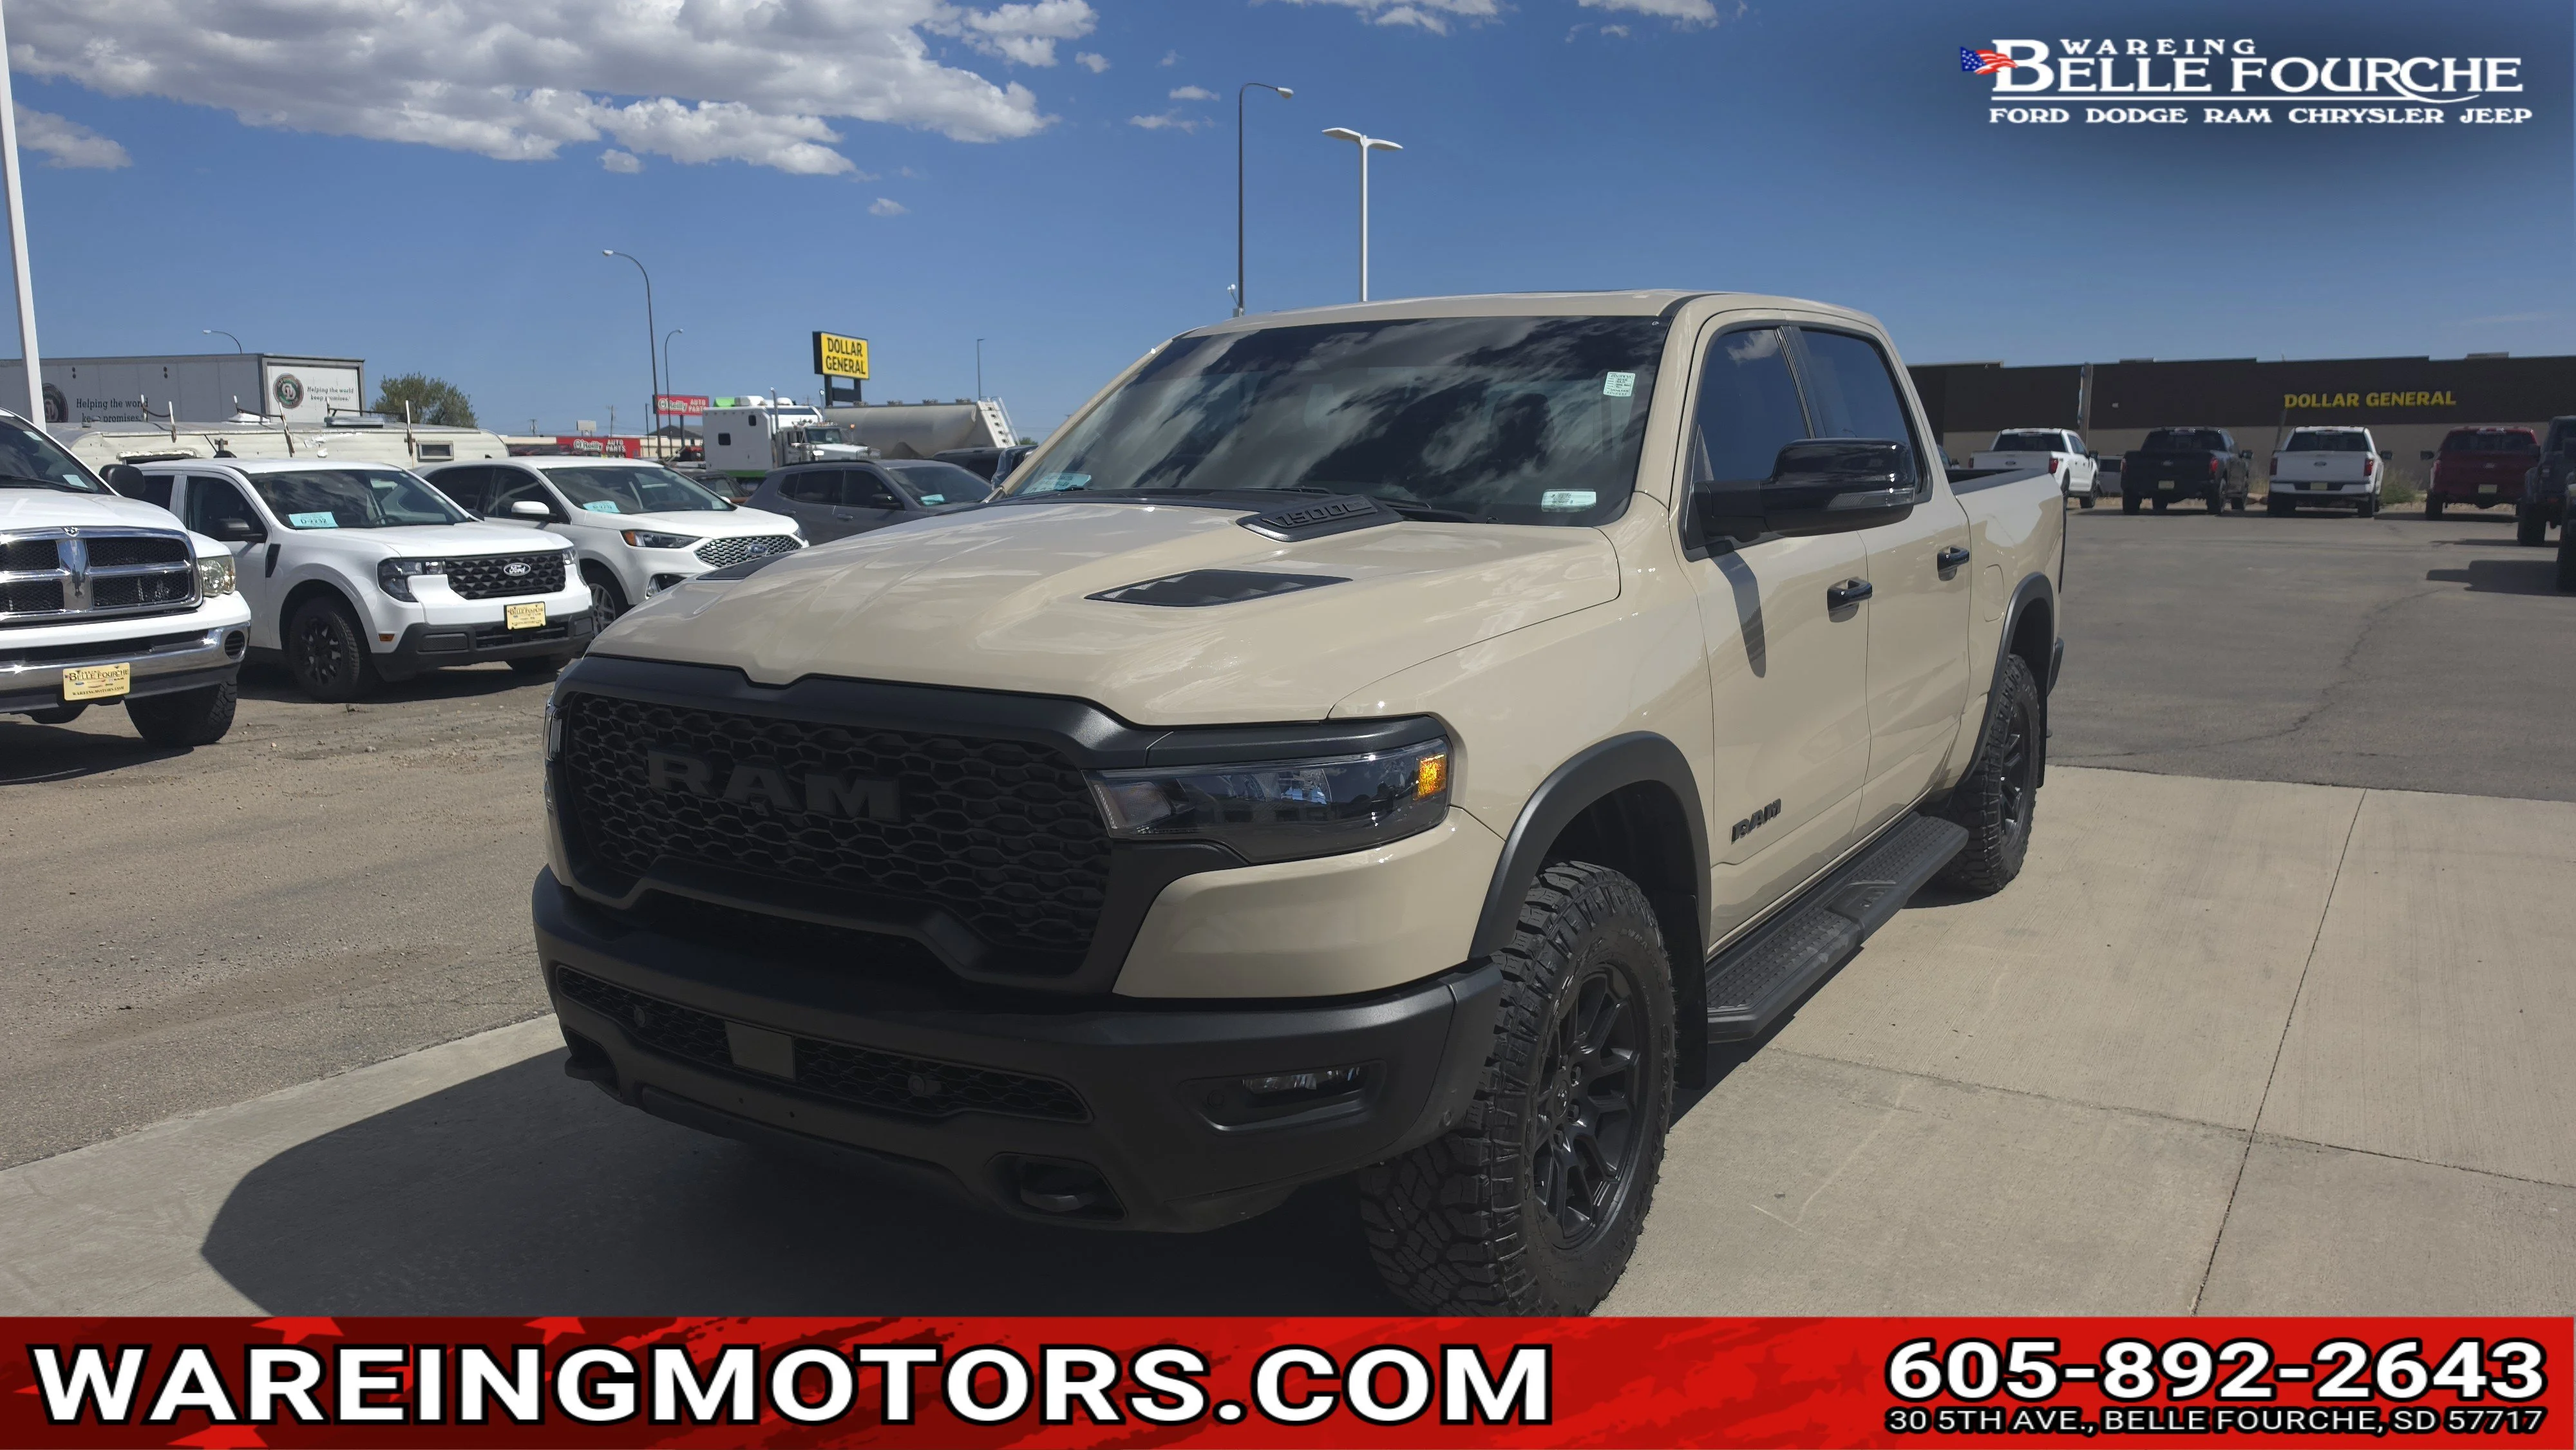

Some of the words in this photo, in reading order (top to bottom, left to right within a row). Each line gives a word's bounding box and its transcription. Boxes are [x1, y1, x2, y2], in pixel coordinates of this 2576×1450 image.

[827, 337, 863, 357] DOLLAR
[826, 355, 866, 375] GENERAL
[76, 398, 108, 410] Helping
[111, 398, 122, 408] the
[126, 397, 148, 408] word
[2284, 393, 2360, 408] DOLLAR
[2365, 391, 2457, 407] GENERAL
[647, 749, 902, 822] RAM
[1730, 798, 1781, 845] RAM
